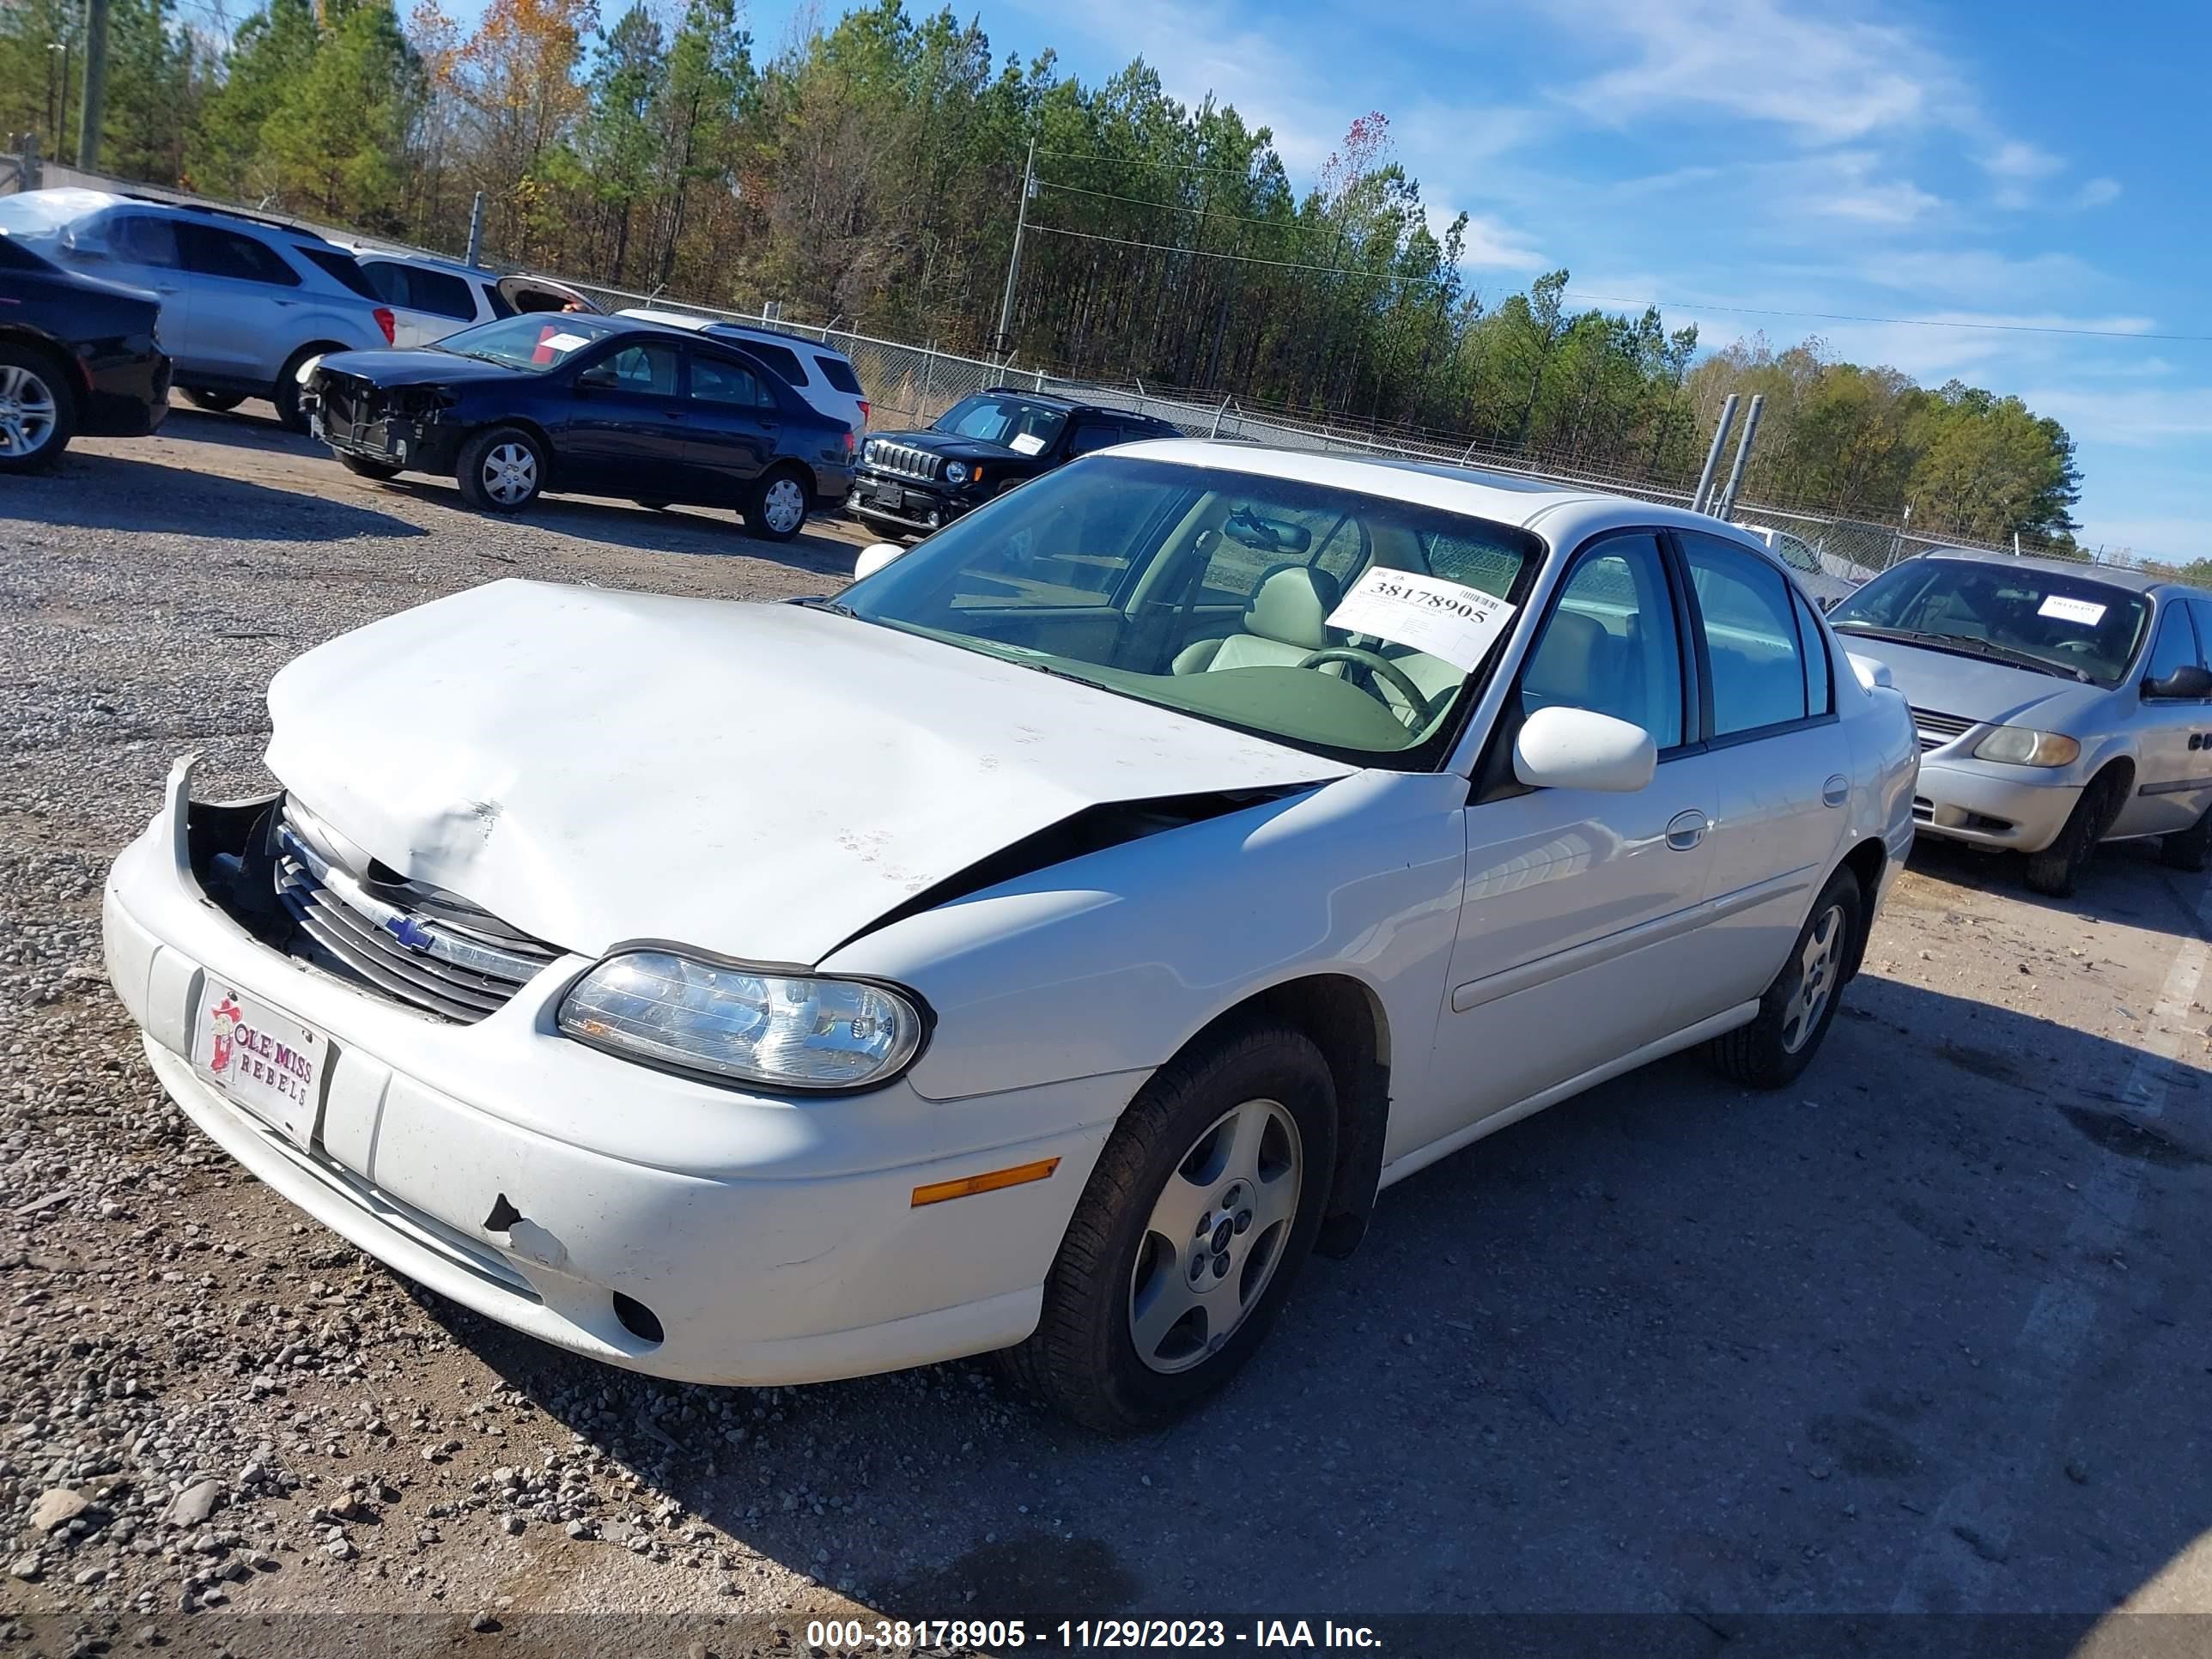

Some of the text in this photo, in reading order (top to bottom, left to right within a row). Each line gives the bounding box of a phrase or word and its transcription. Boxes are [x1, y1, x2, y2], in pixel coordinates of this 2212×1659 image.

[1370, 582, 1489, 624] 38178905
[234, 1023, 313, 1085] OLE MISS
[240, 1054, 307, 1107] REBELS
